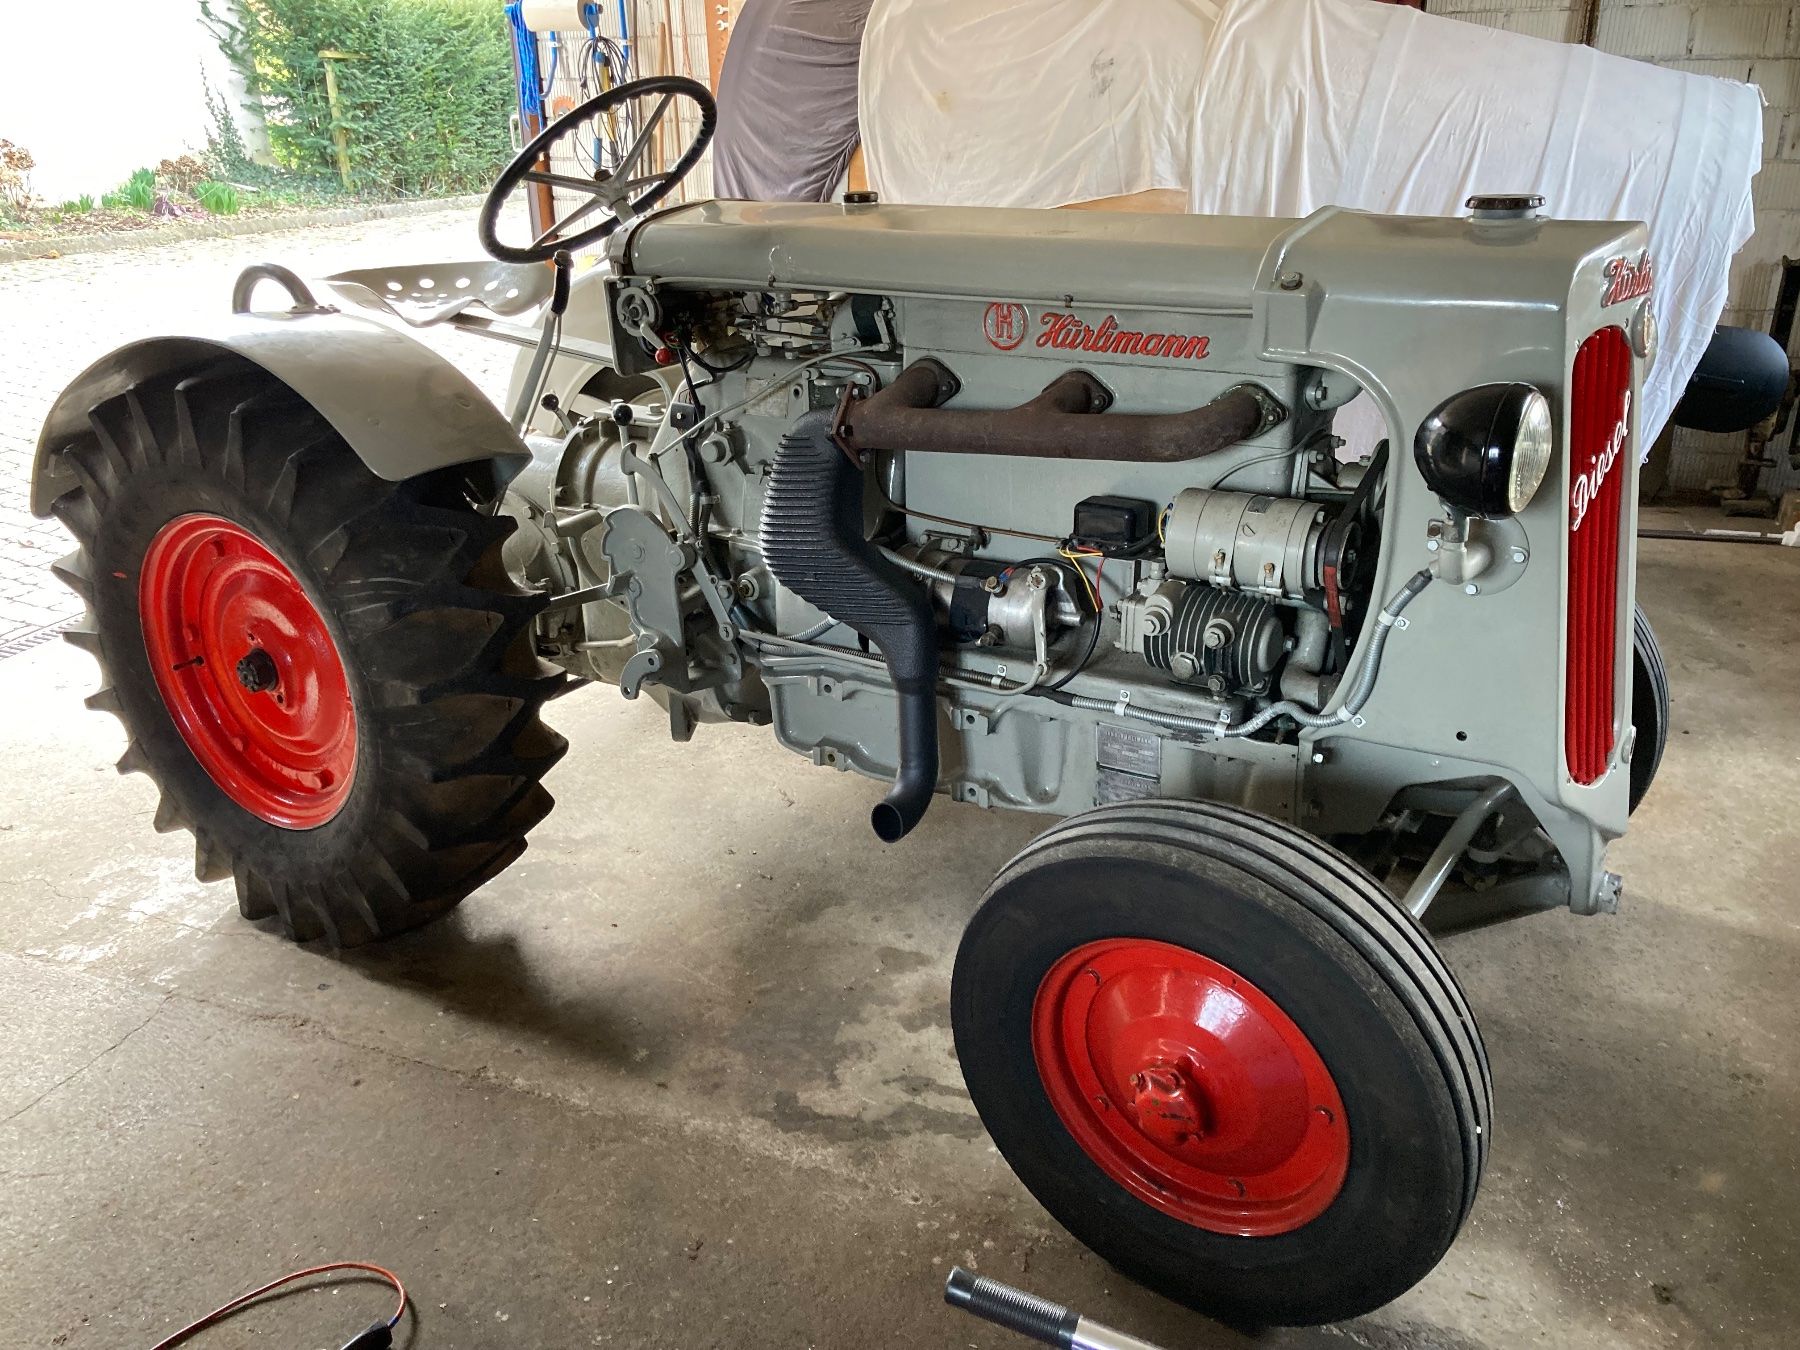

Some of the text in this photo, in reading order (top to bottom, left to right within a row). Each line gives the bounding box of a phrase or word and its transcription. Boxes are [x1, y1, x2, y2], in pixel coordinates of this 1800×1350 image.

[1601, 249, 1652, 308] Hürli
[1035, 312, 1210, 359] Hürlimann
[1570, 390, 1632, 531] Diesel
